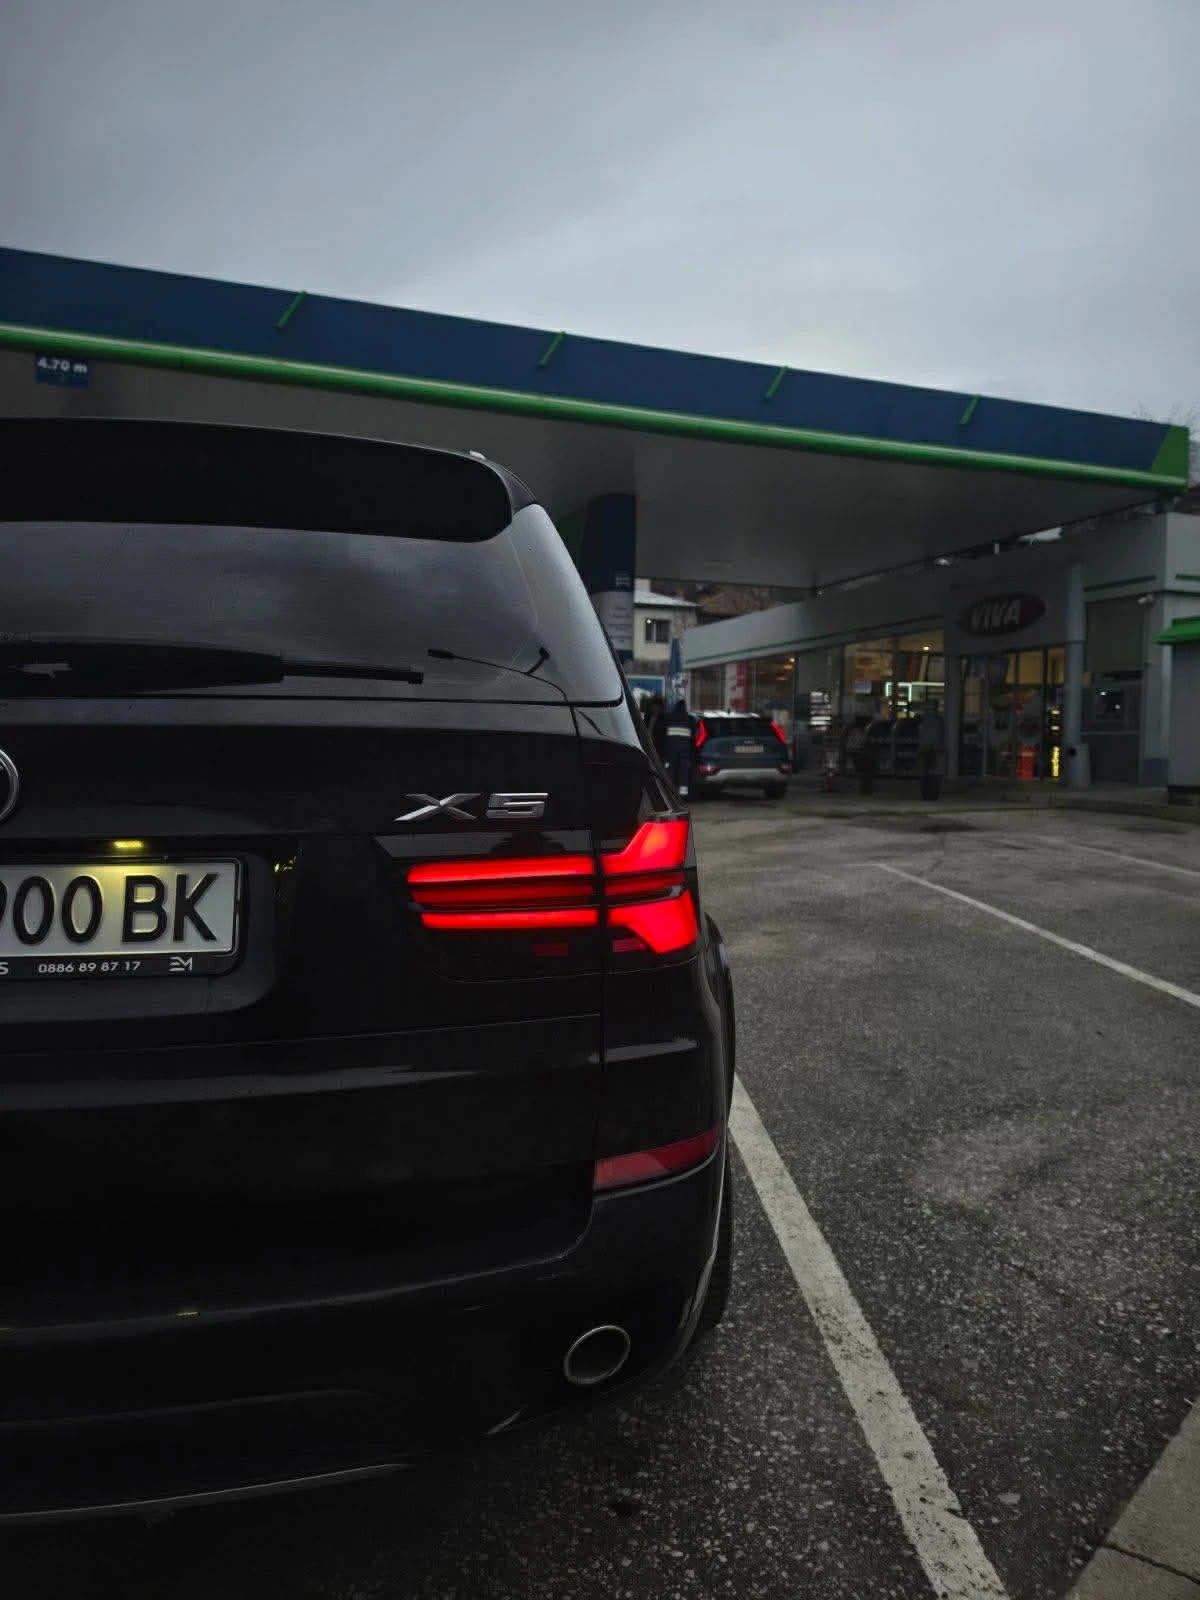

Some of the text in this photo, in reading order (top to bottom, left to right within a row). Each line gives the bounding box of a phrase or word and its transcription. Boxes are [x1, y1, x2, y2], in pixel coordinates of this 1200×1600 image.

[37, 357, 88, 373] 4.70 m
[971, 599, 1020, 630] VIVA
[393, 792, 549, 821] X5
[0, 872, 218, 945] 00 BK
[38, 962, 75, 974] 0886
[78, 962, 97, 972] 89
[101, 961, 118, 972] 87
[124, 960, 141, 971] 17
